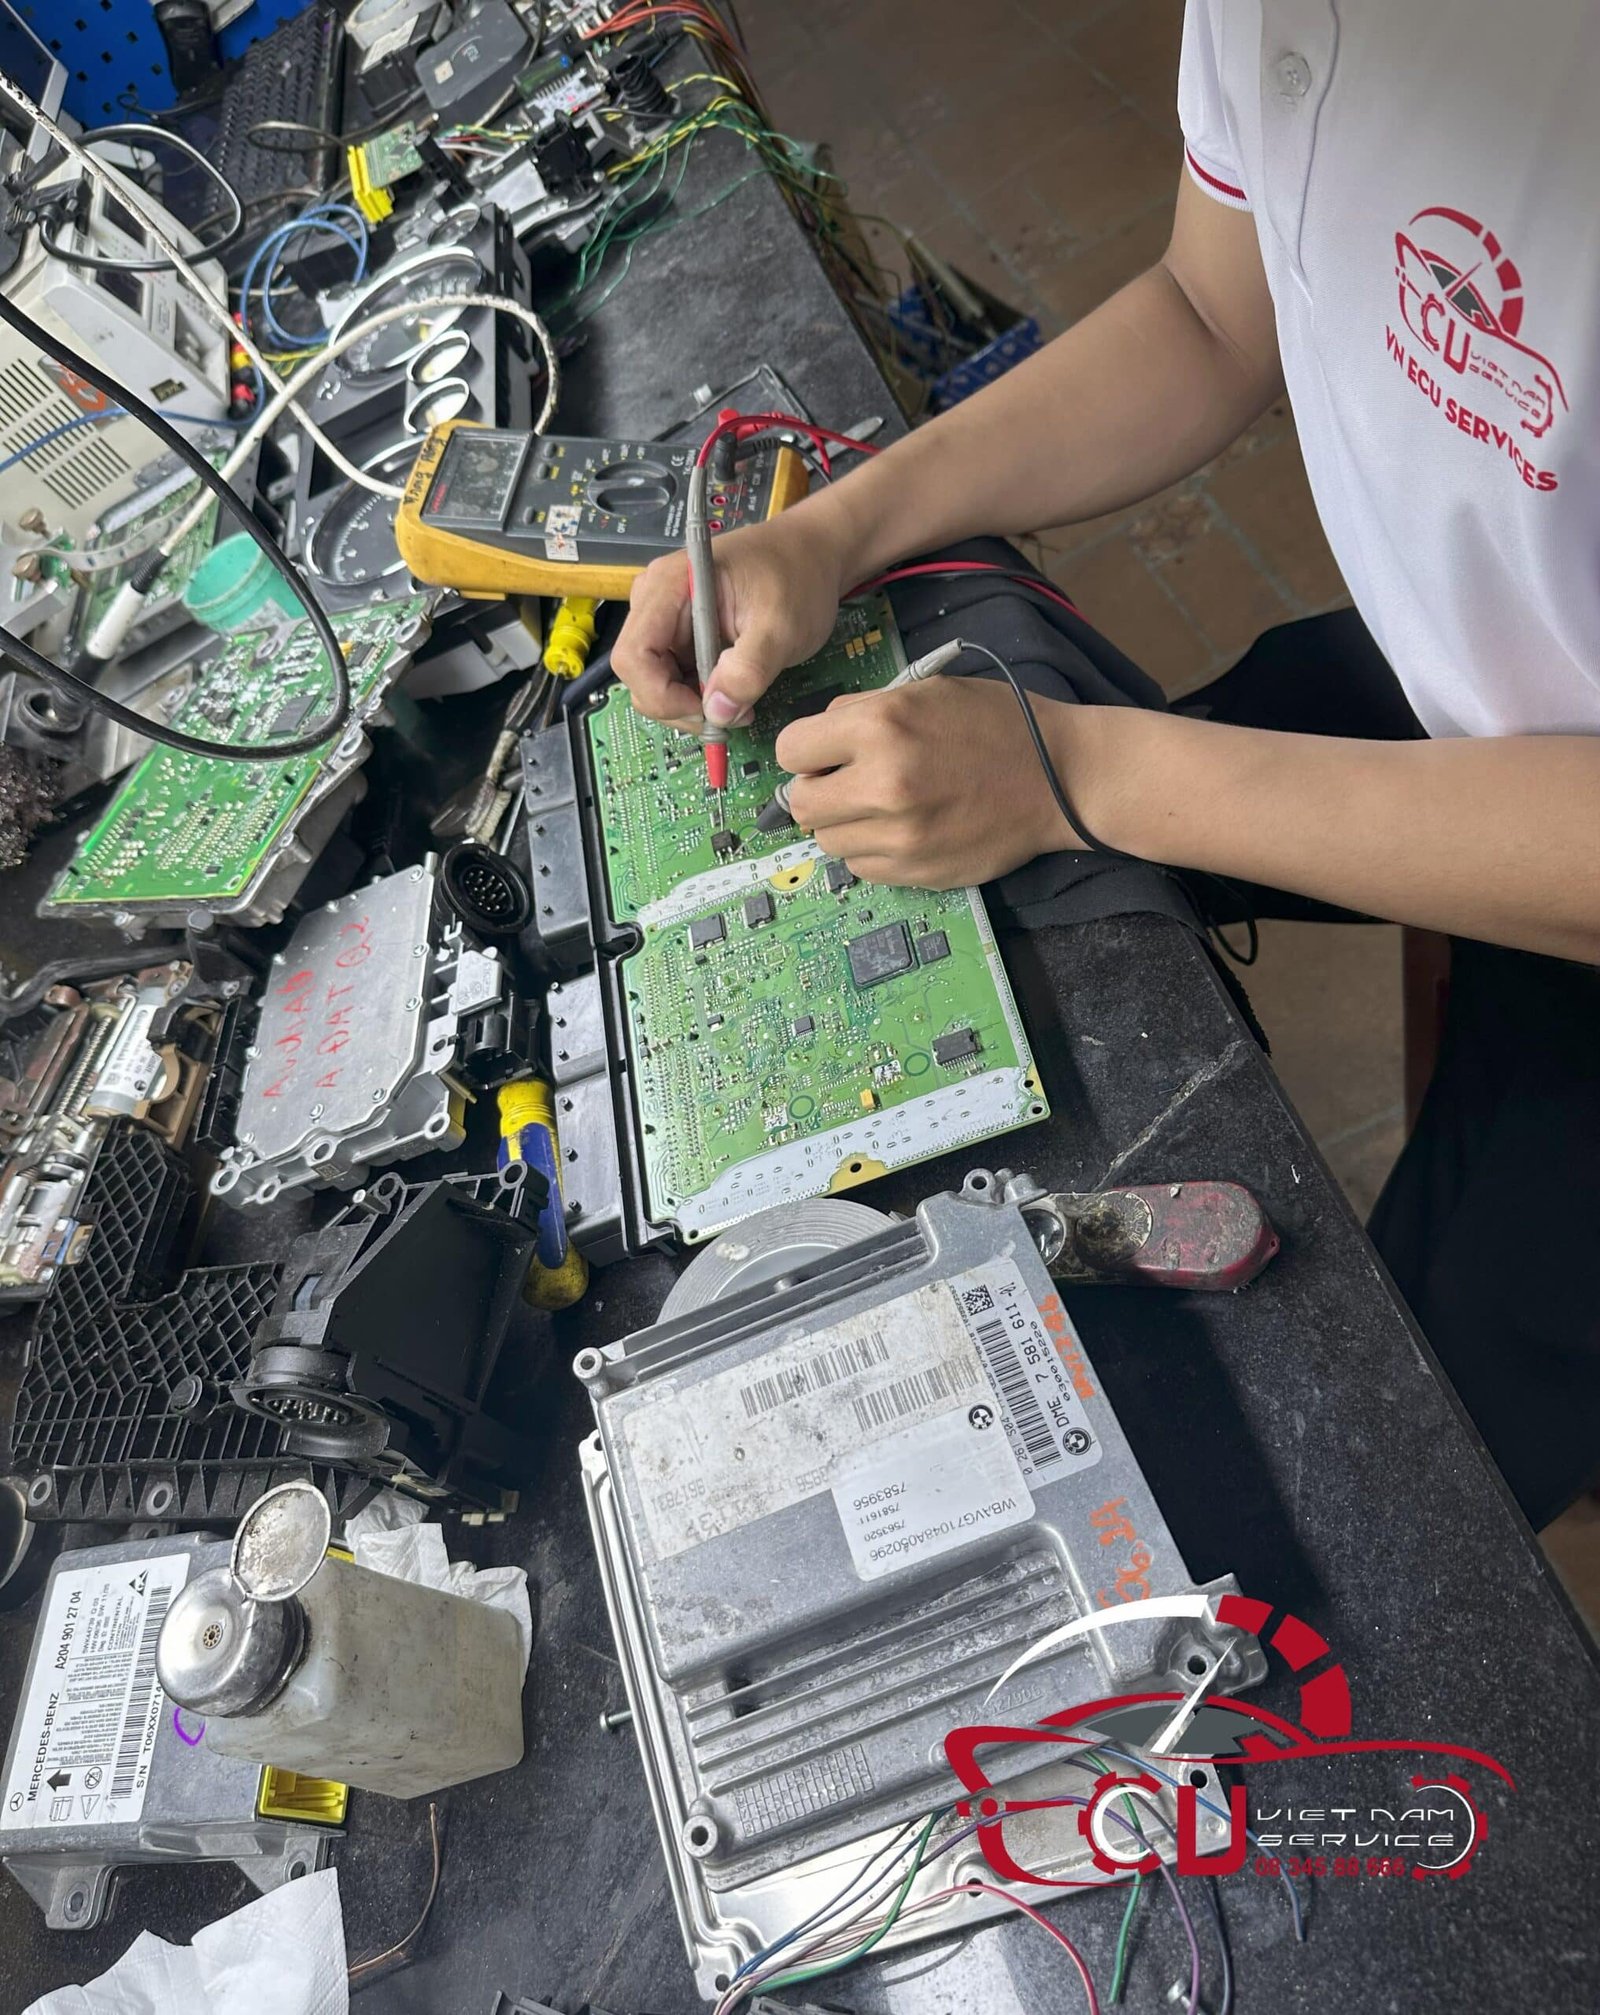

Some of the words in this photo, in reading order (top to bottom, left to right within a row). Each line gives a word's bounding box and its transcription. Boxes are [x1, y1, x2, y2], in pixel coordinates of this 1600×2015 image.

[1386, 324, 1405, 369] VN
[1408, 356, 1441, 408] ECU
[1445, 398, 1558, 492] SERVICES
[1004, 1302, 1025, 1330] 611
[1019, 1336, 1041, 1365] 581
[1029, 1320, 1071, 1402] 030015220
[1034, 1370, 1049, 1384] 7
[1045, 1396, 1070, 1427] DME
[851, 1480, 907, 1511] 7583956
[858, 1501, 900, 1524] 7581611
[863, 1519, 907, 1541] 7563520
[70, 1591, 82, 1604] 04
[66, 1607, 79, 1619] 27
[107, 1596, 123, 1651] CONTINENTAL
[61, 1623, 75, 1641] 901
[54, 1643, 70, 1669] A204
[27, 1692, 60, 1802] MERCEDES-BENZ
[136, 1765, 148, 1789] S/N
